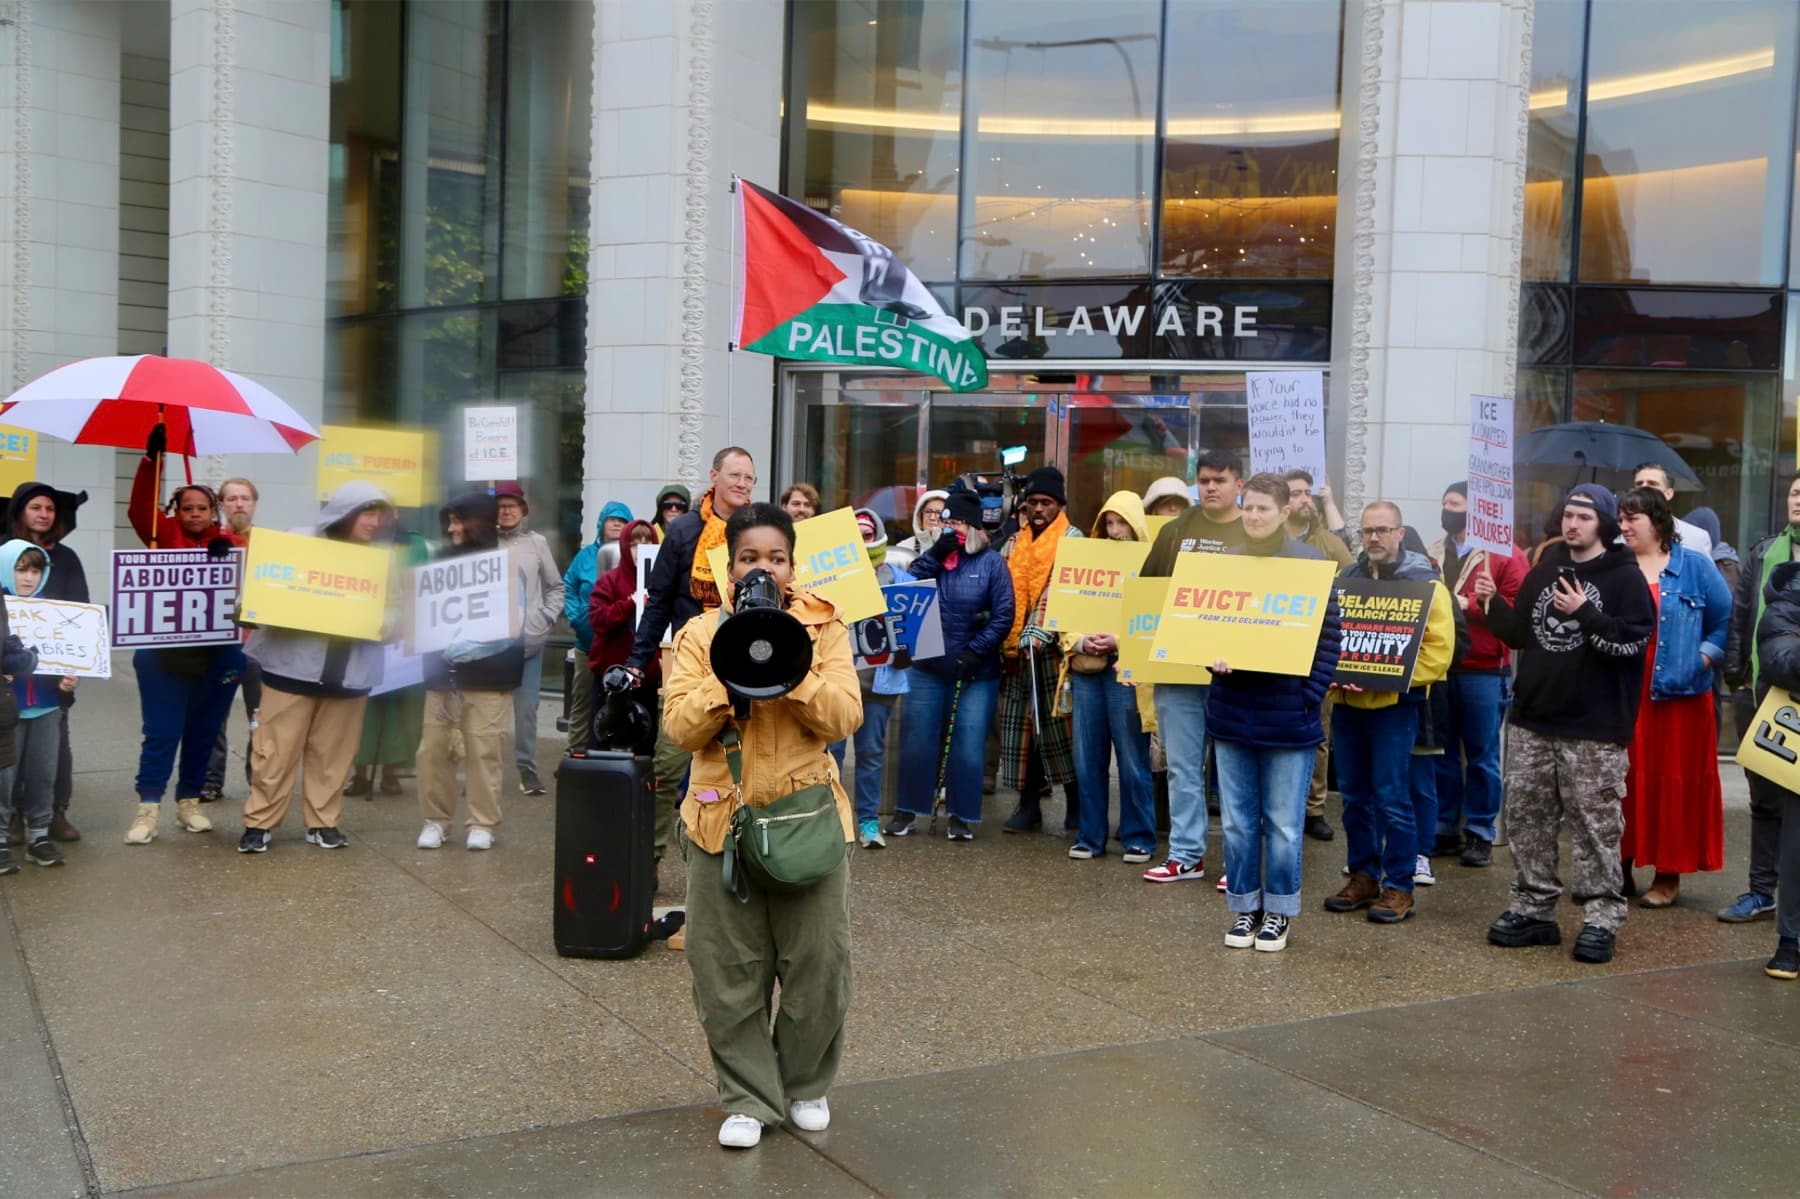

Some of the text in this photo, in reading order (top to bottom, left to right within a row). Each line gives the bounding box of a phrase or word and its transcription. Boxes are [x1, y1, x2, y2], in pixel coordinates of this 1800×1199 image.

[964, 305, 1259, 337] DELAWARE
[1283, 395, 1300, 409] had
[1480, 400, 1497, 421] ICE
[1305, 424, 1320, 436] be
[1254, 443, 1304, 462] trying to
[119, 554, 147, 564] YOUR
[150, 553, 208, 564] NEIGHBORS
[808, 542, 861, 575] ICE!
[122, 566, 234, 588] ABDUCTED
[307, 569, 380, 599] FUERA!
[418, 556, 502, 598] ABOLISH
[1059, 566, 1121, 588] EVICT
[118, 590, 236, 634] HERE
[430, 590, 490, 628] ICE
[1174, 587, 1318, 618] EVICT ICE!
[1199, 613, 1220, 623] FROM
[1238, 617, 1282, 627] DELAWARE
[1346, 608, 1388, 621] MARCH
[1349, 630, 1366, 638] YOU
[1367, 631, 1378, 639] TO
[1378, 632, 1412, 642] CHOOSE
[1385, 625, 1416, 634] NORTH
[39, 643, 87, 658] BRES
